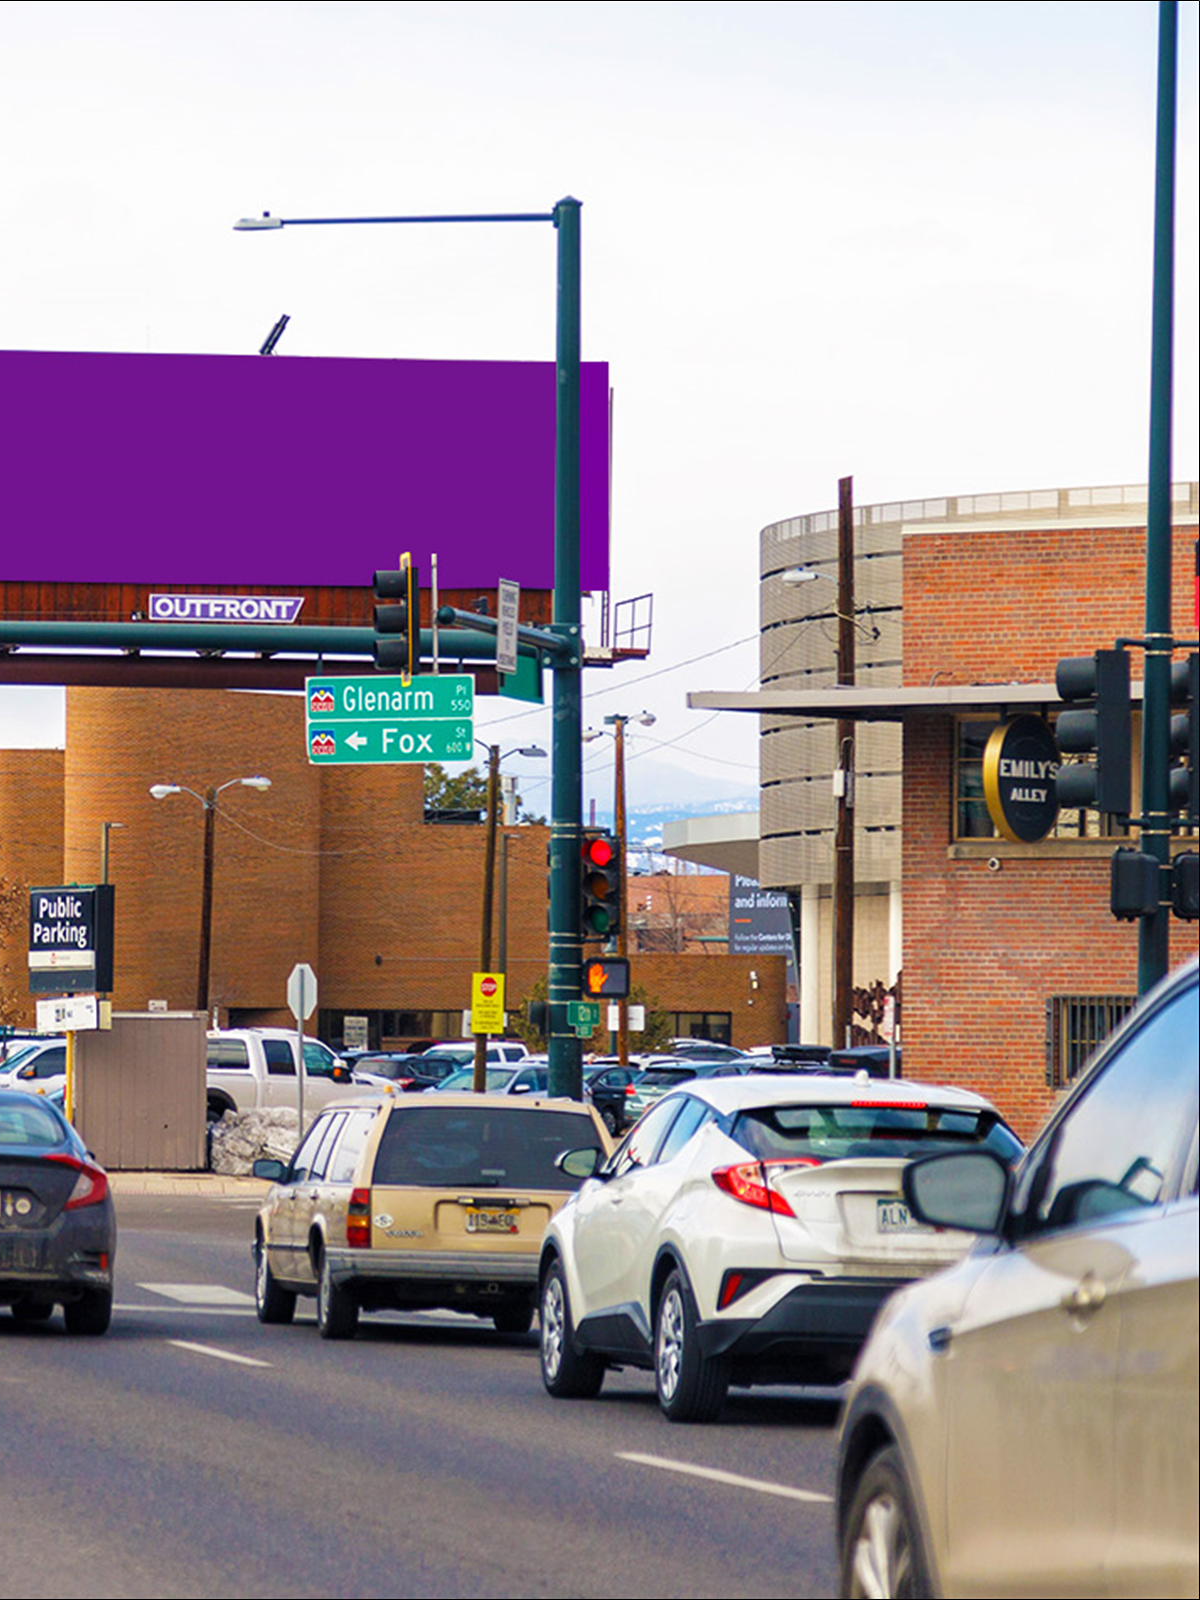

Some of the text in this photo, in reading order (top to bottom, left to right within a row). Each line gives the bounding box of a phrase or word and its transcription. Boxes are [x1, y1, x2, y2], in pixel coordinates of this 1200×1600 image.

[154, 597, 295, 620] OUTFRONT
[343, 685, 434, 712] Glenarm
[456, 685, 467, 696] Pl
[451, 699, 471, 712] 550
[382, 728, 434, 754] Fox
[456, 727, 466, 738] St
[1000, 759, 1060, 780] EMILY'S
[1010, 788, 1048, 802] ALLEY
[39, 896, 82, 919] Public
[734, 892, 755, 908] and
[33, 921, 88, 949] Parking
[481, 982, 497, 992] STOP
[881, 1208, 908, 1225] ALN
